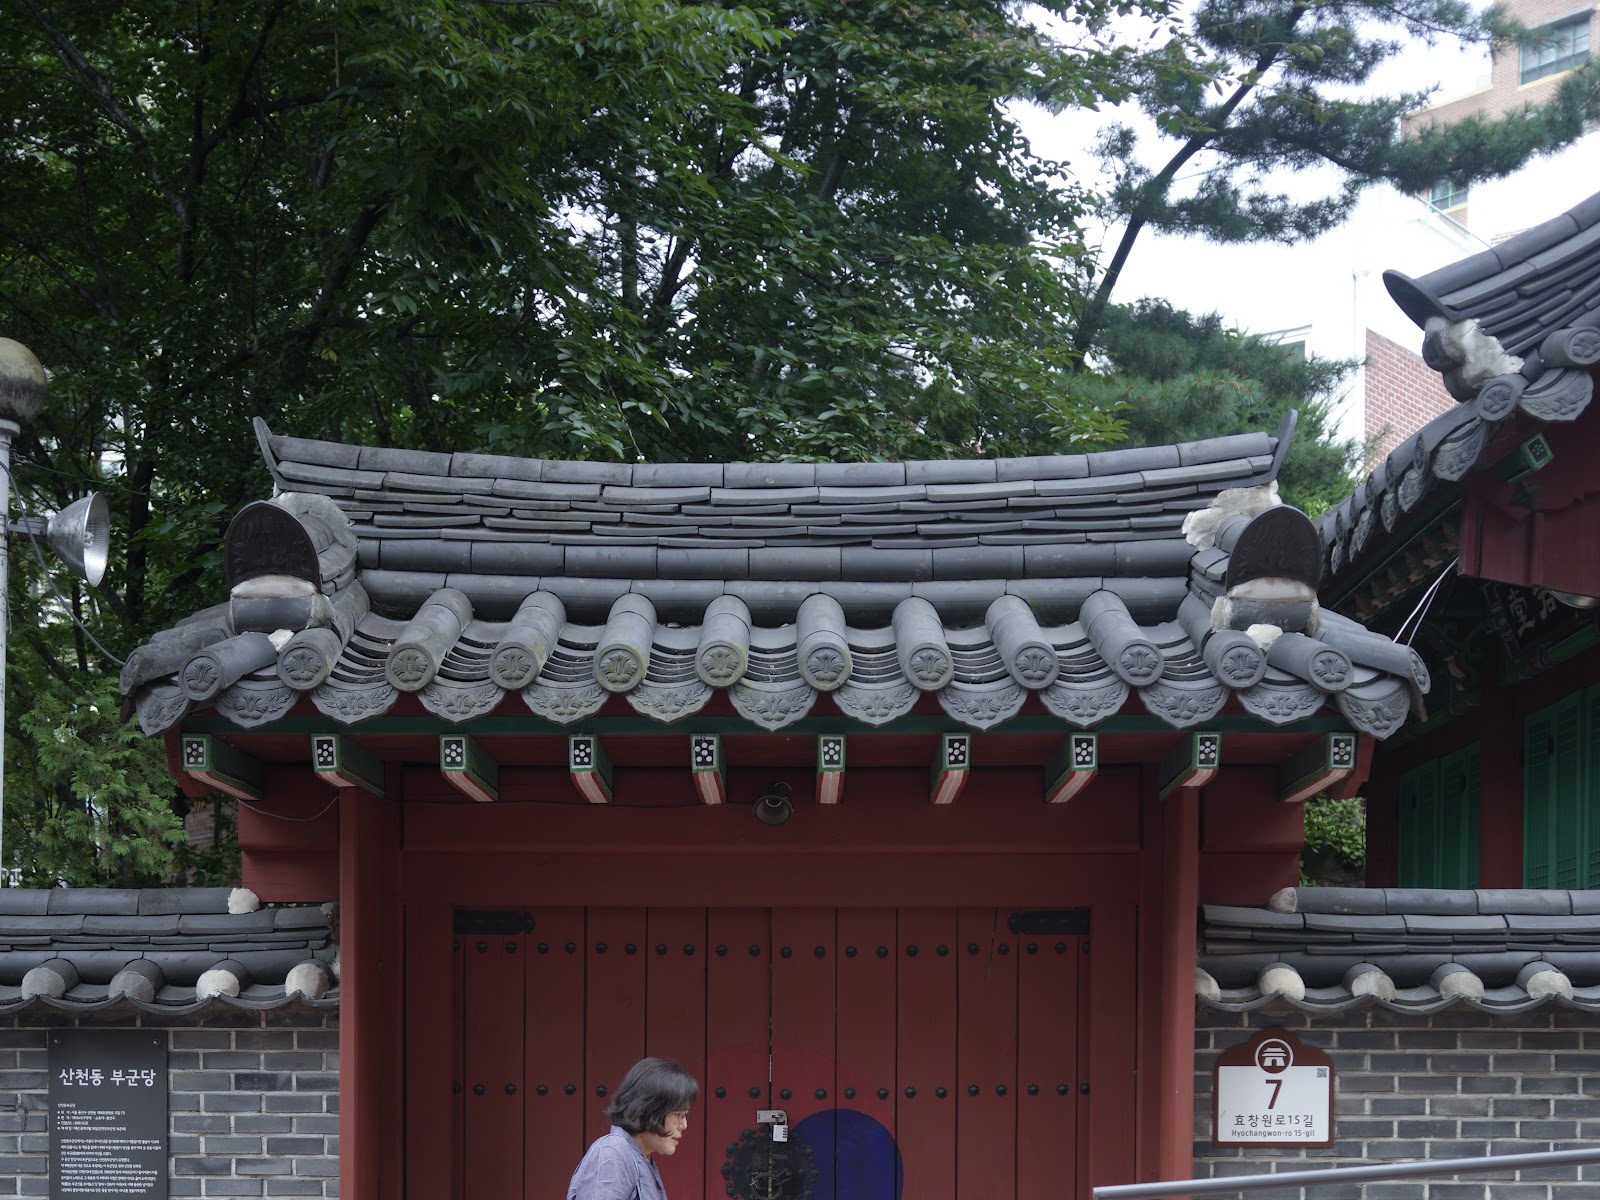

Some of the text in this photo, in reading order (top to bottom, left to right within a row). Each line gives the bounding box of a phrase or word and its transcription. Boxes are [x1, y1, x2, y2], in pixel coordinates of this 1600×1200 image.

[59, 1068, 156, 1087] 산천동 부군당
[1265, 1079, 1283, 1110] 7
[1234, 1114, 1314, 1128] 효창원로15길
[1231, 1129, 1315, 1138] Hyochangwon-ro 15-gil
